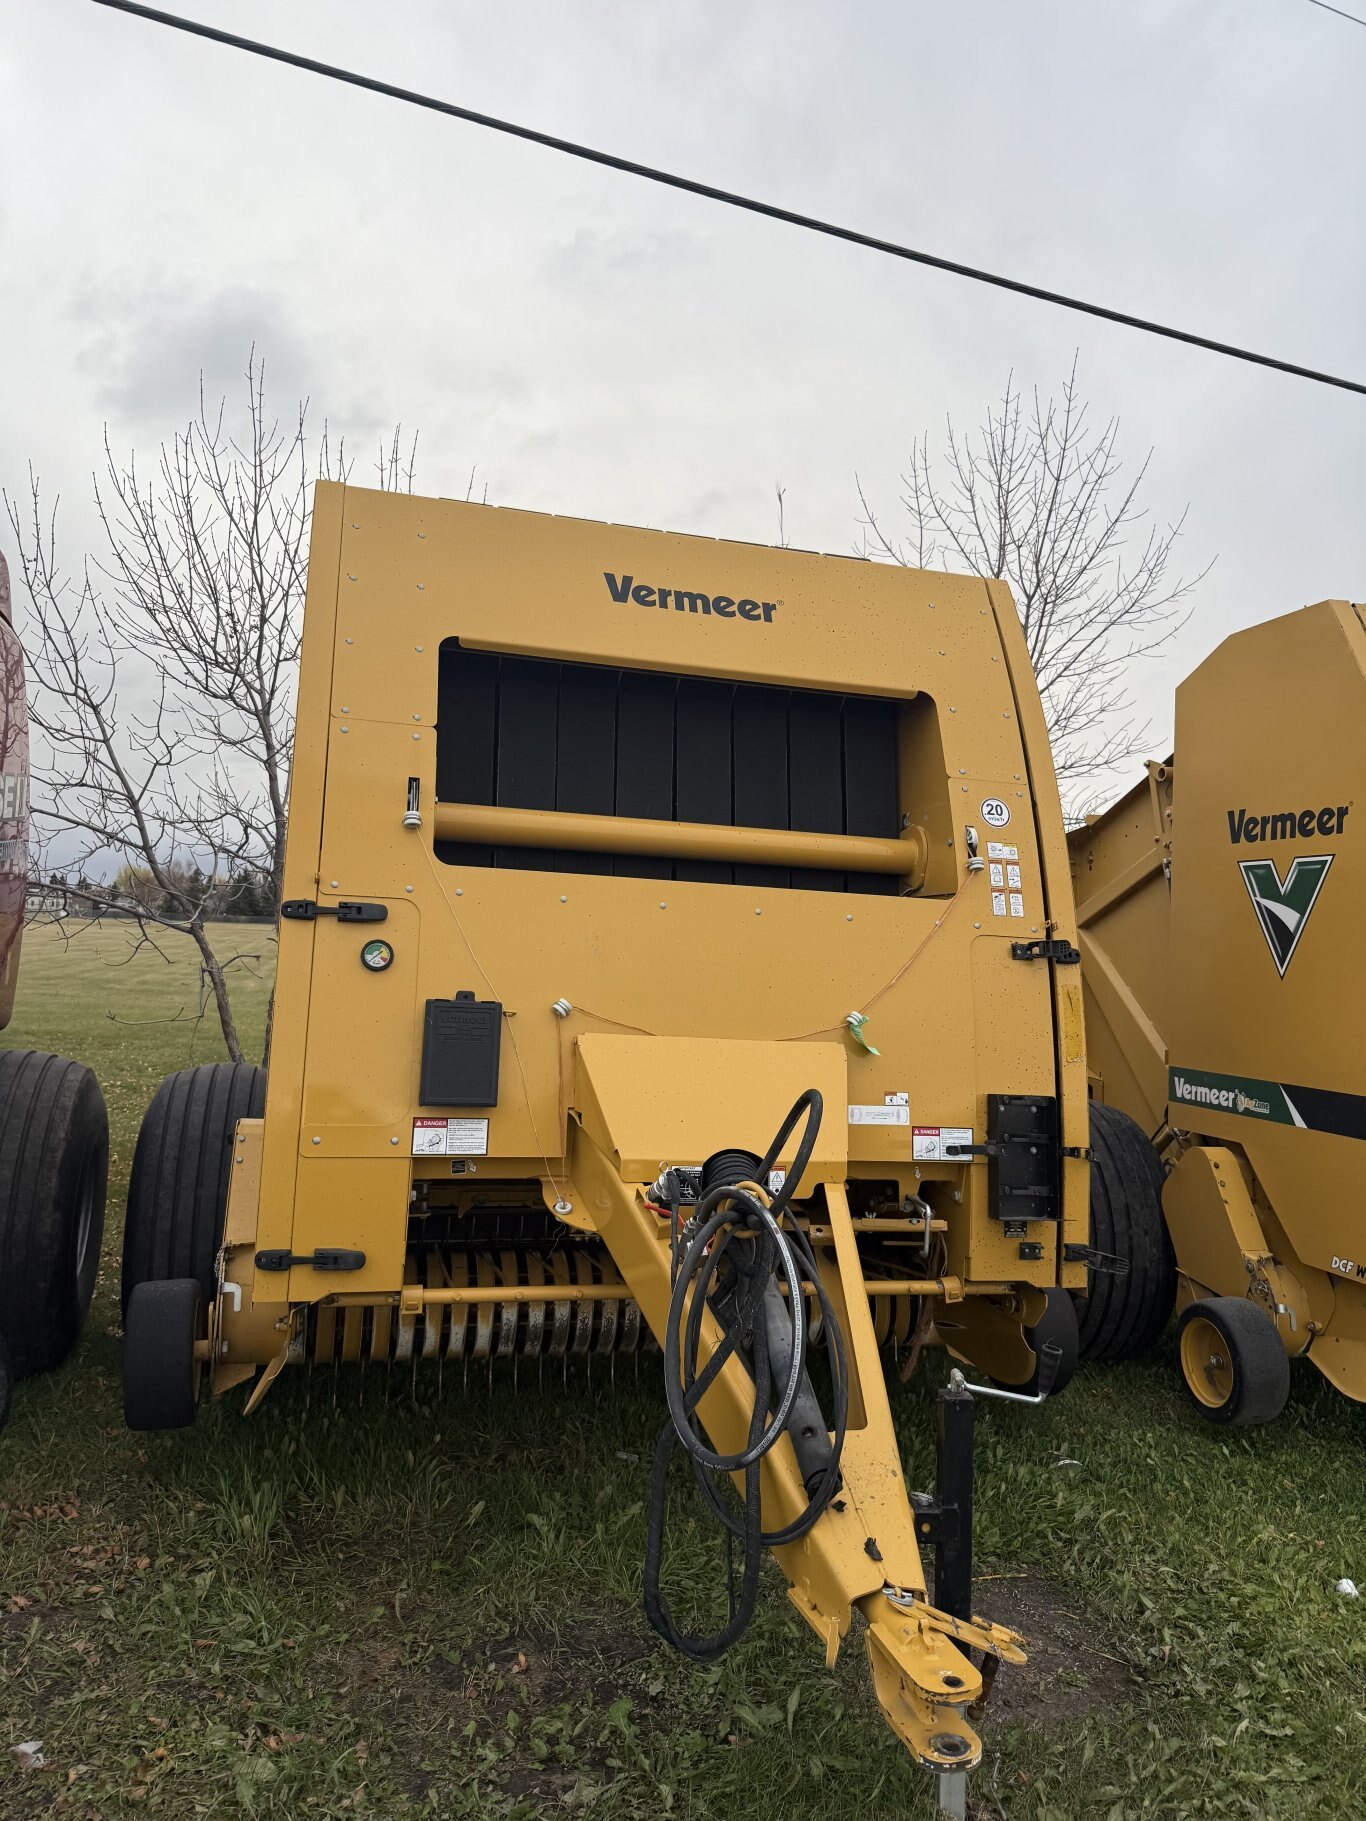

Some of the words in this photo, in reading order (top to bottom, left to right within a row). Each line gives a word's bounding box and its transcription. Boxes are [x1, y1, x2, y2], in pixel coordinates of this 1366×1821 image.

[603, 572, 777, 623] Vermeer
[986, 803, 1004, 817] 20
[1227, 805, 1349, 844] Vermeer
[1174, 1076, 1235, 1108] Vermeer
[1331, 1255, 1354, 1273] DCF
